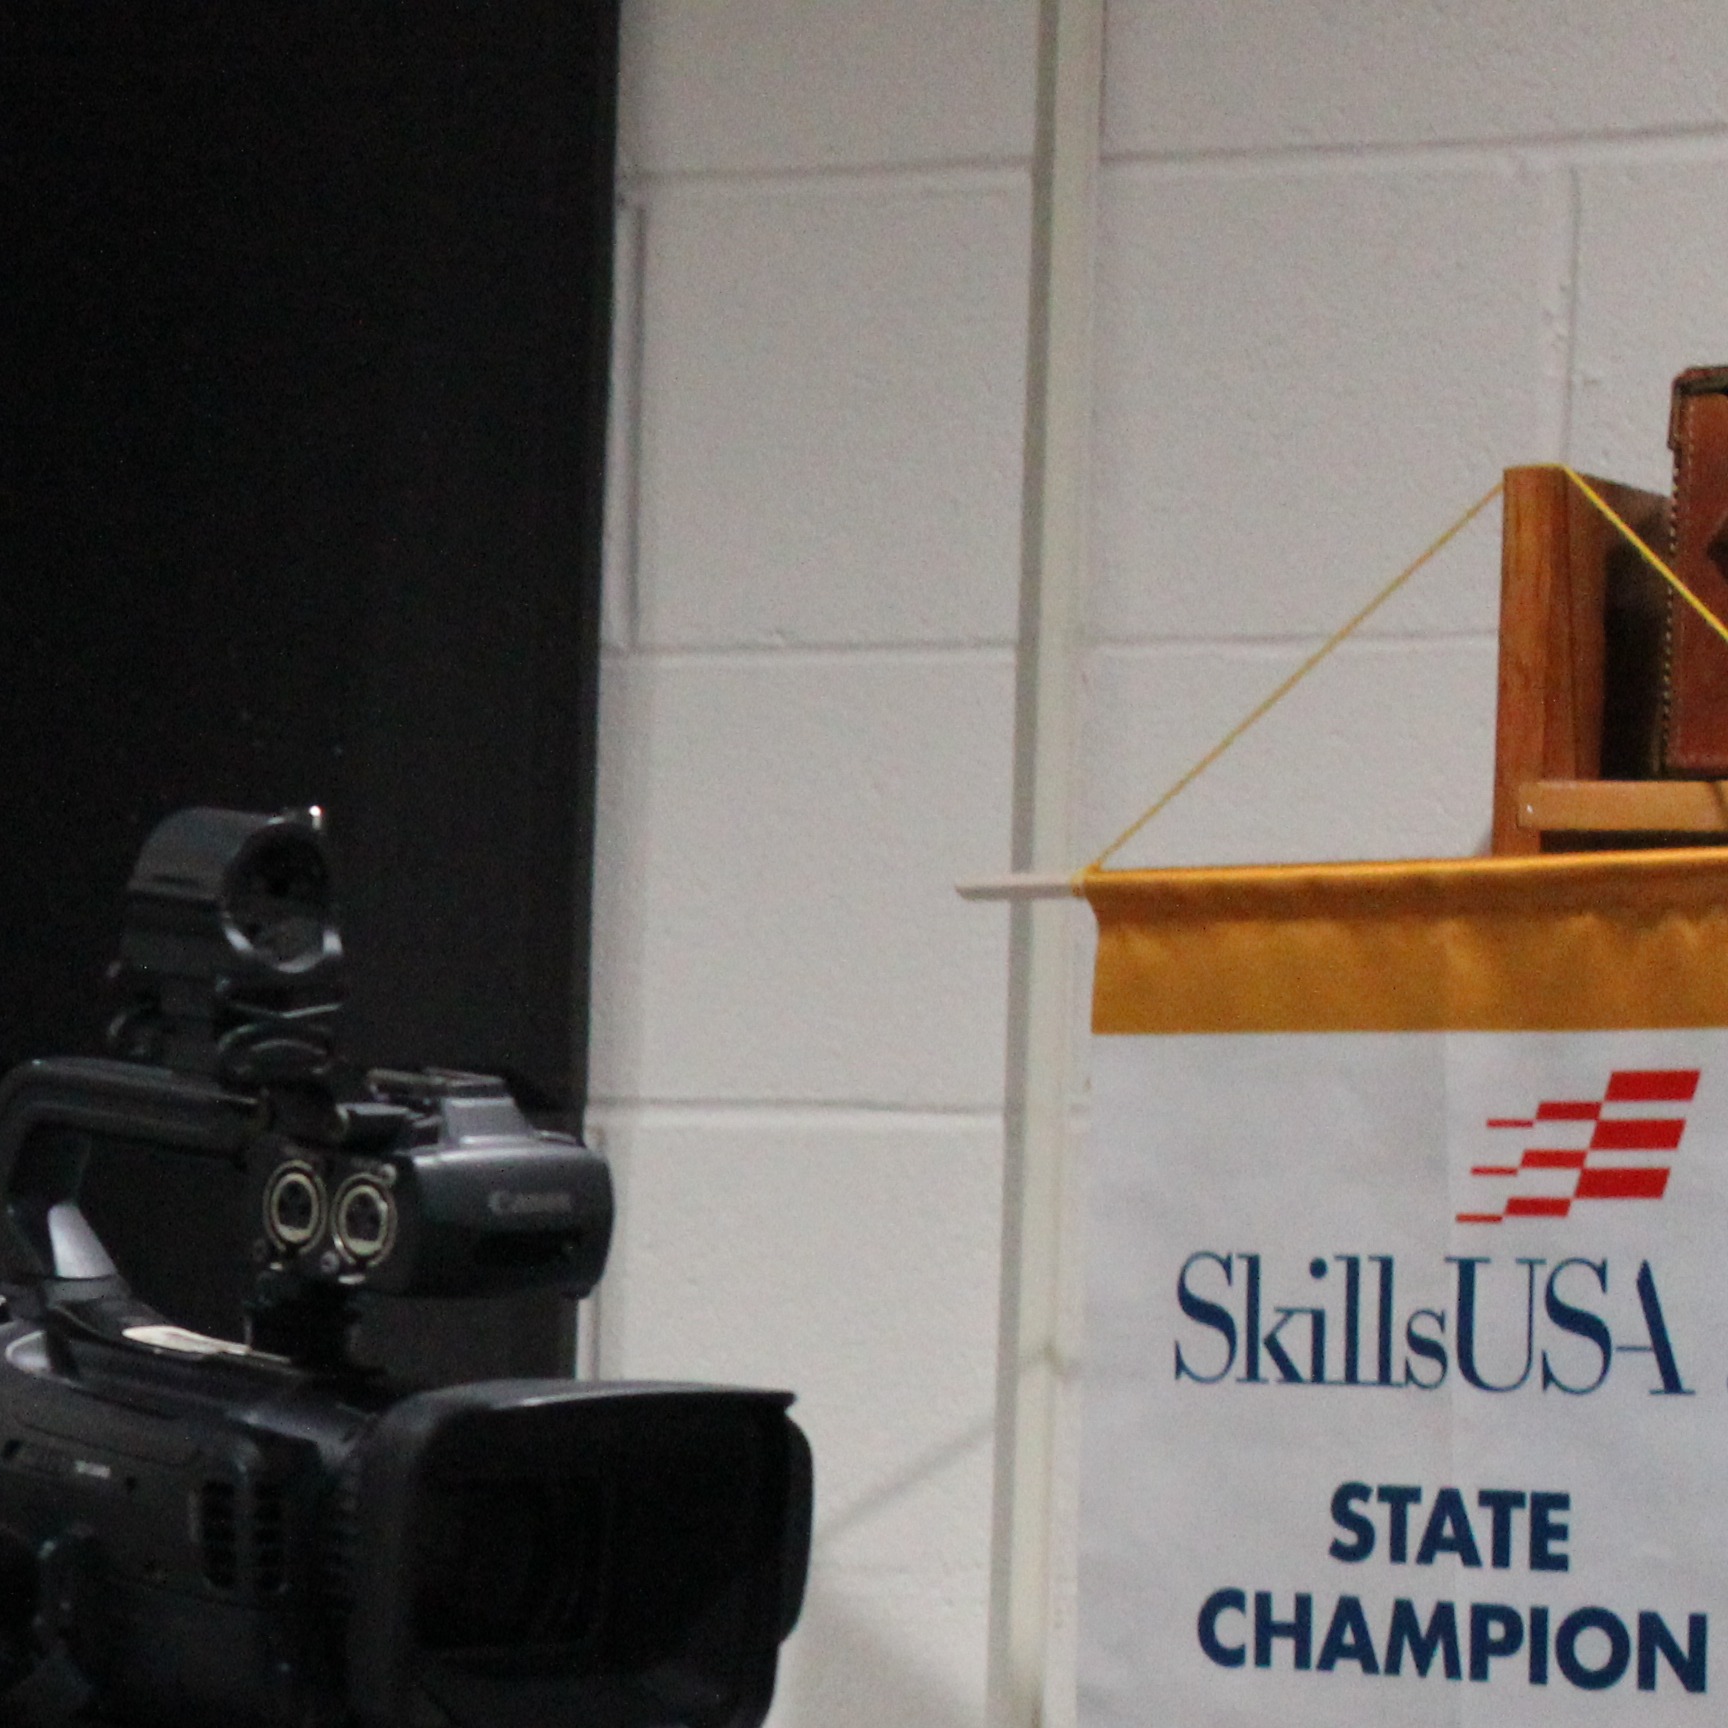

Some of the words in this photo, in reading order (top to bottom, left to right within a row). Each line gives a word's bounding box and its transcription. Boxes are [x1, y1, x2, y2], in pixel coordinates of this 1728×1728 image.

[1174, 1251, 1696, 1394] SkillsUSA
[1329, 1481, 1571, 1572] STATE
[1197, 1586, 1708, 1694] CHAMPION
